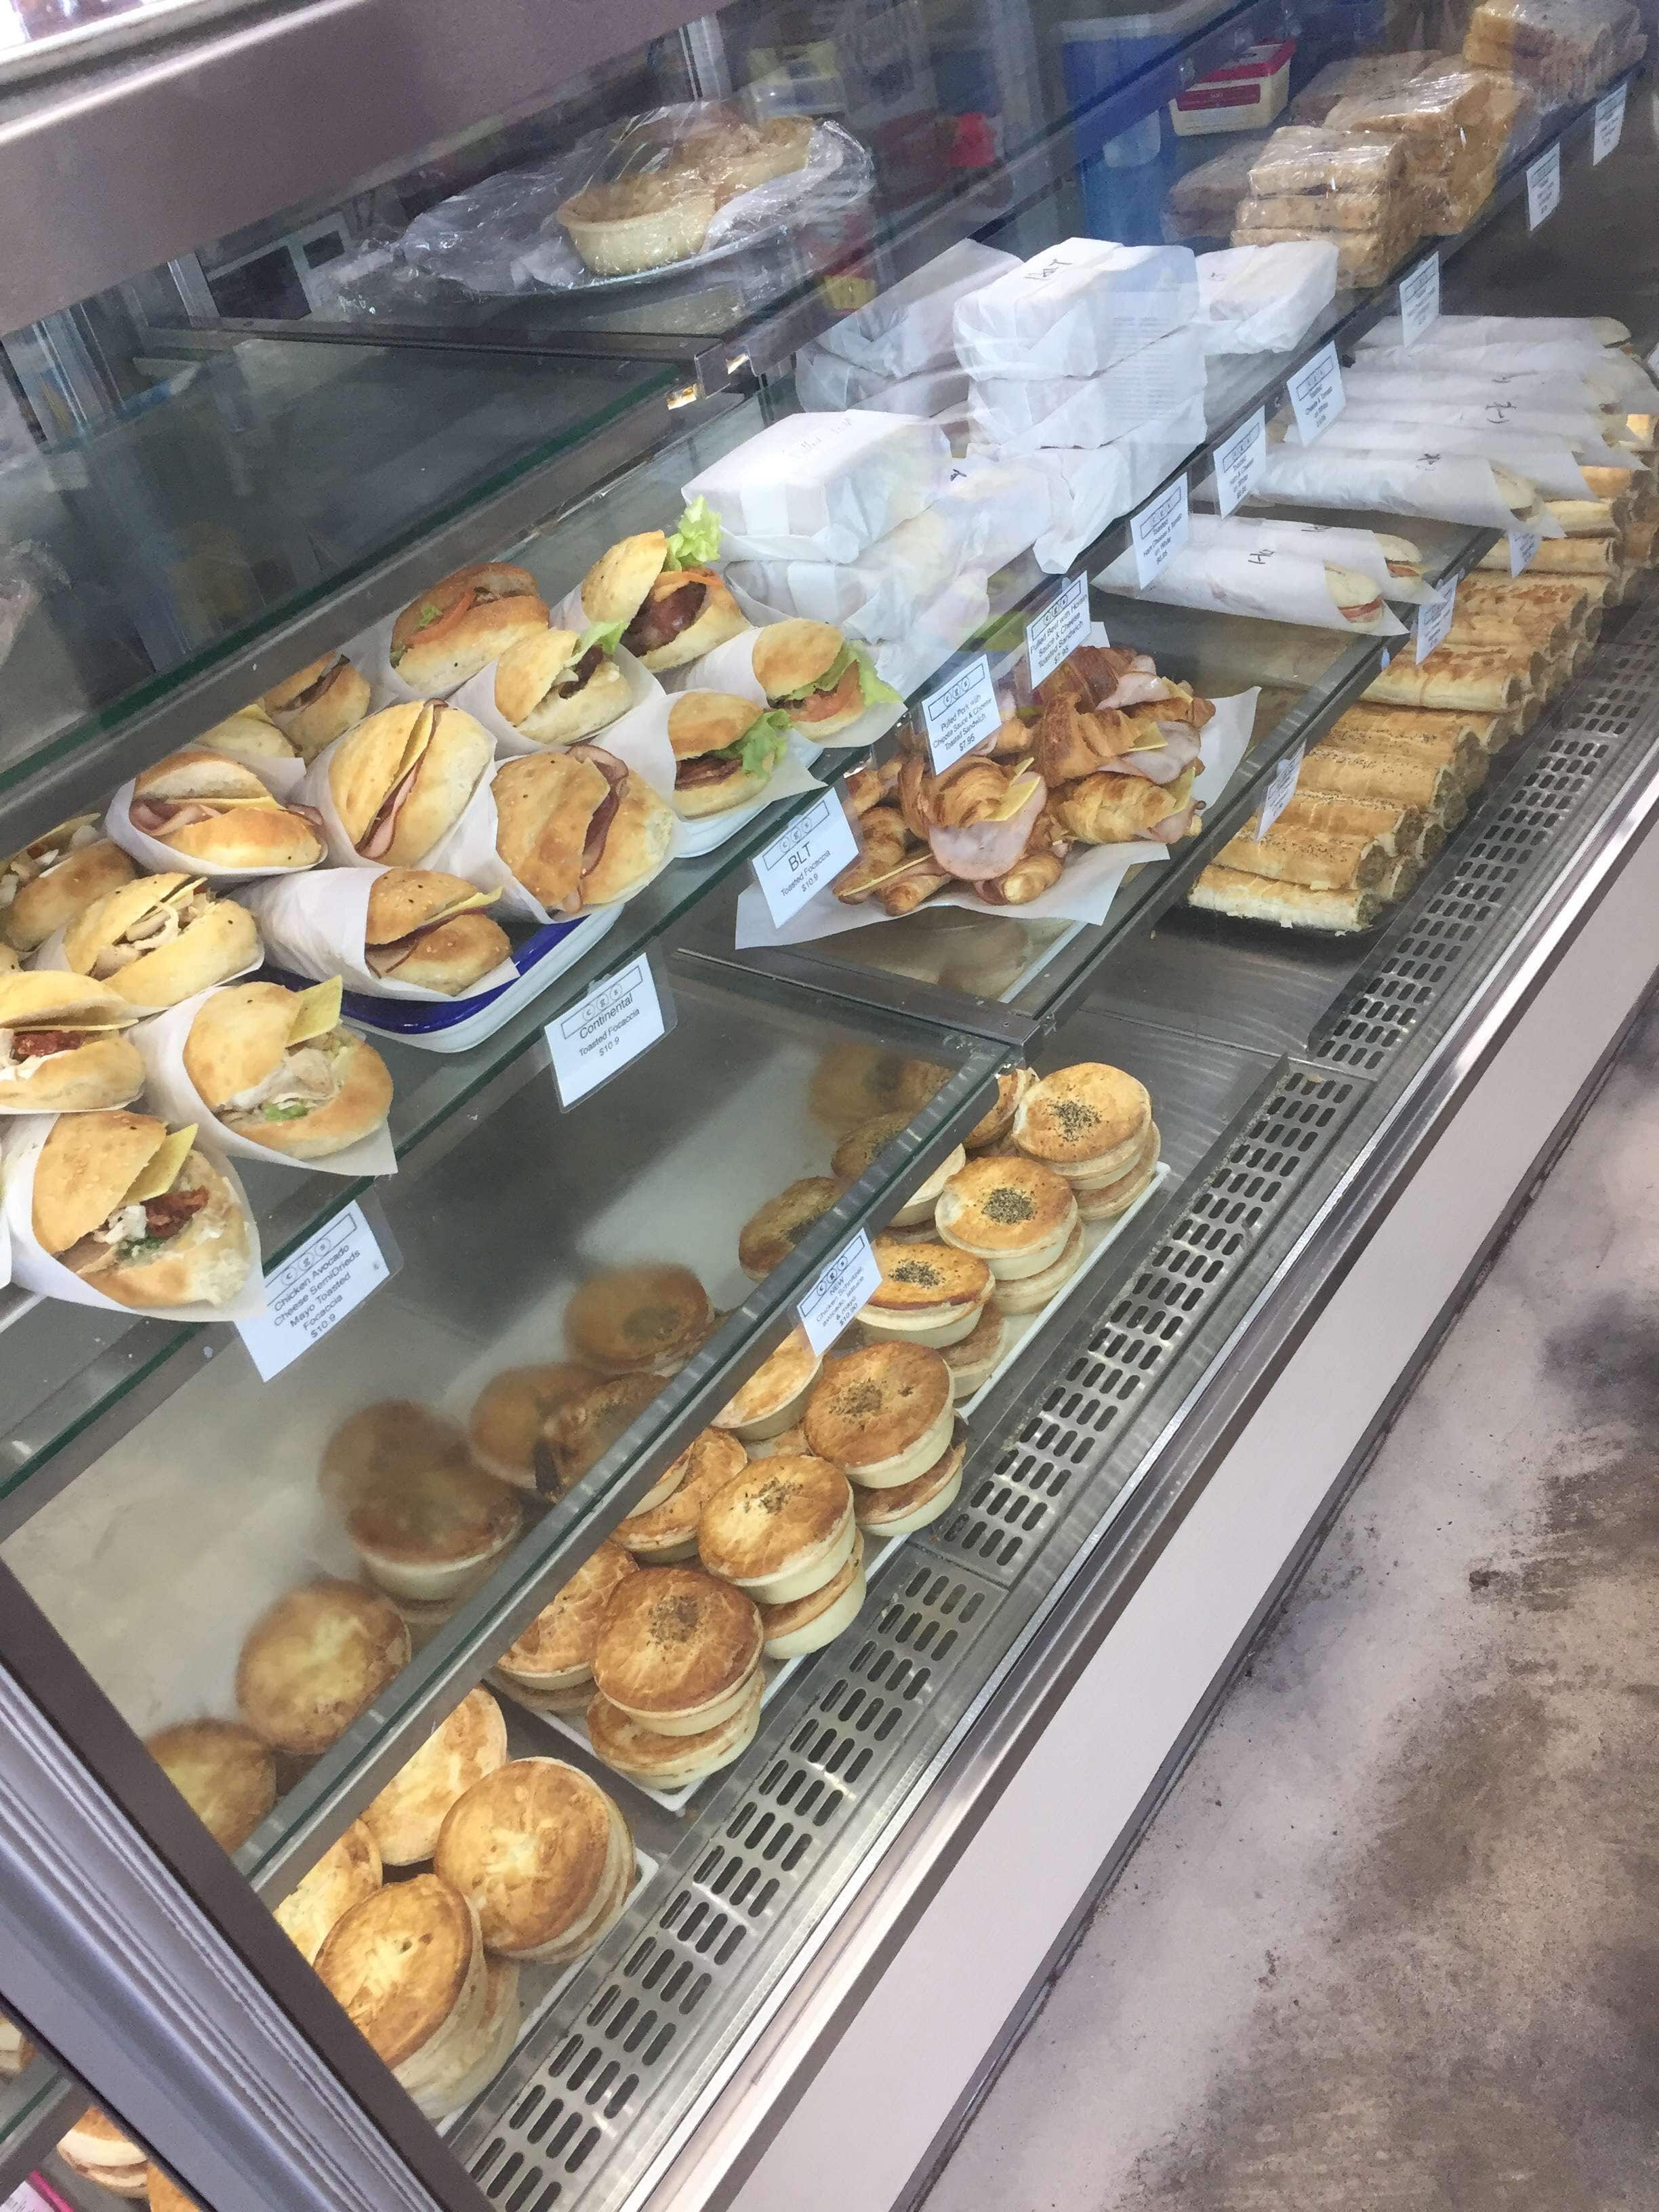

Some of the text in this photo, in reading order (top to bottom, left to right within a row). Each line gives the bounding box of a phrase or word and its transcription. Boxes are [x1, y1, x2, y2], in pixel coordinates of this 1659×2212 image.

[781, 850, 831, 896] Toasted Focaccia
[788, 841, 811, 872] BLT
[801, 873, 818, 892] $10.9
[578, 993, 633, 1039] Continental
[579, 1009, 640, 1056] Toasted Focaccia
[599, 1036, 619, 1057] $10.9
[274, 1245, 349, 1311] Chicken Avocado
[274, 1294, 308, 1326] Cheese
[290, 1271, 351, 1327] Mayo Toasted
[303, 1294, 343, 1330] Focaccia
